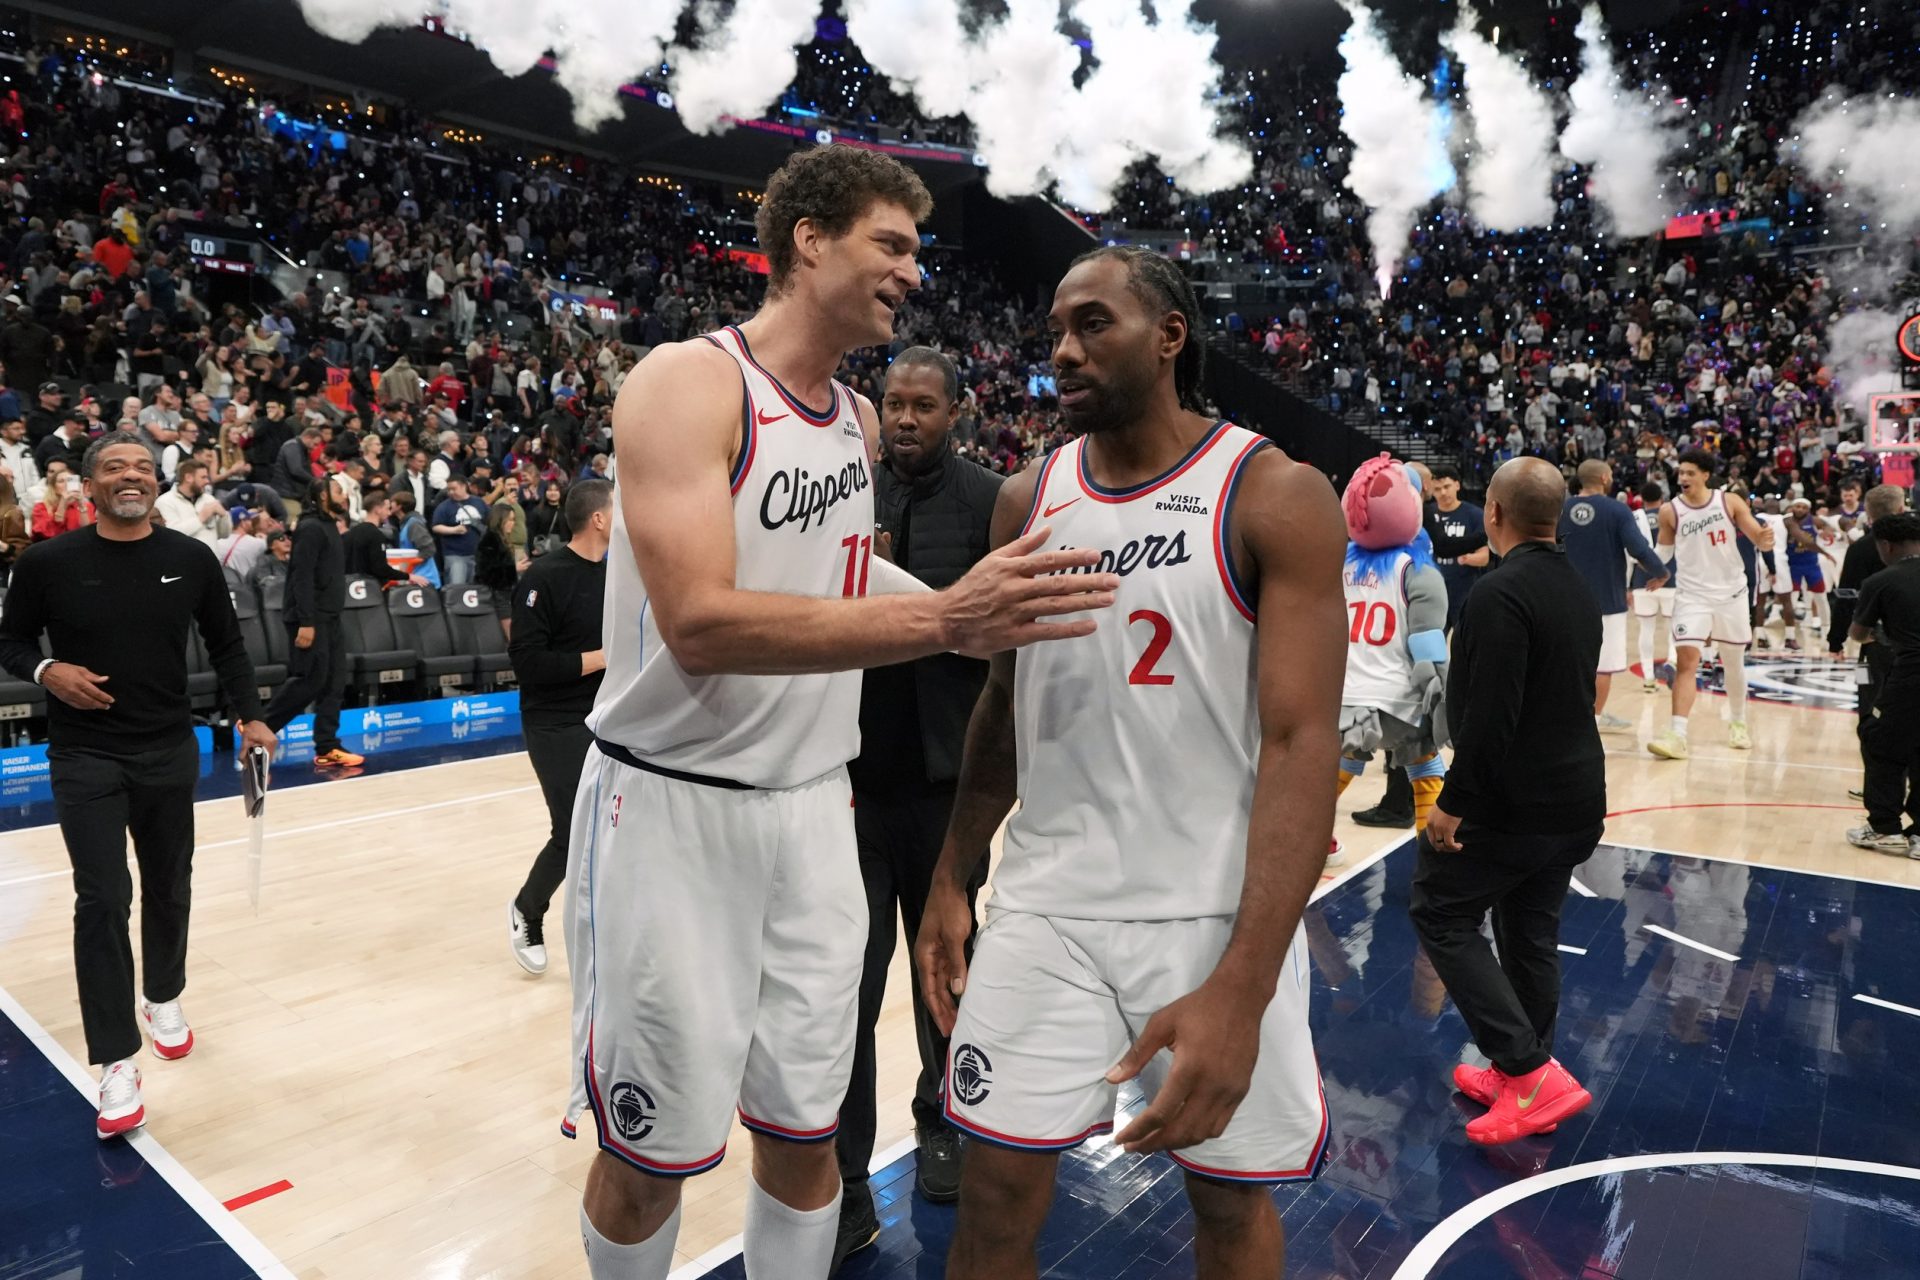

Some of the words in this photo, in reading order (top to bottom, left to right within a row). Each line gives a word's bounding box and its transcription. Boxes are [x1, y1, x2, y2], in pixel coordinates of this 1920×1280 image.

[190, 238, 215, 256] 0.0
[600, 307, 616, 320] 114
[760, 456, 868, 533] Clippers
[1170, 494, 1201, 505] VISIT
[1155, 502, 1208, 515] RWANDA
[1681, 512, 1725, 538] Clippers
[1706, 529, 1727, 546] 14
[1049, 529, 1193, 578] pers
[841, 533, 872, 599] 11
[349, 580, 367, 600] G
[406, 589, 424, 608] G
[463, 589, 478, 608] G
[1349, 601, 1396, 647] 10
[1129, 609, 1175, 685] 2
[3, 756, 30, 766] KAISER
